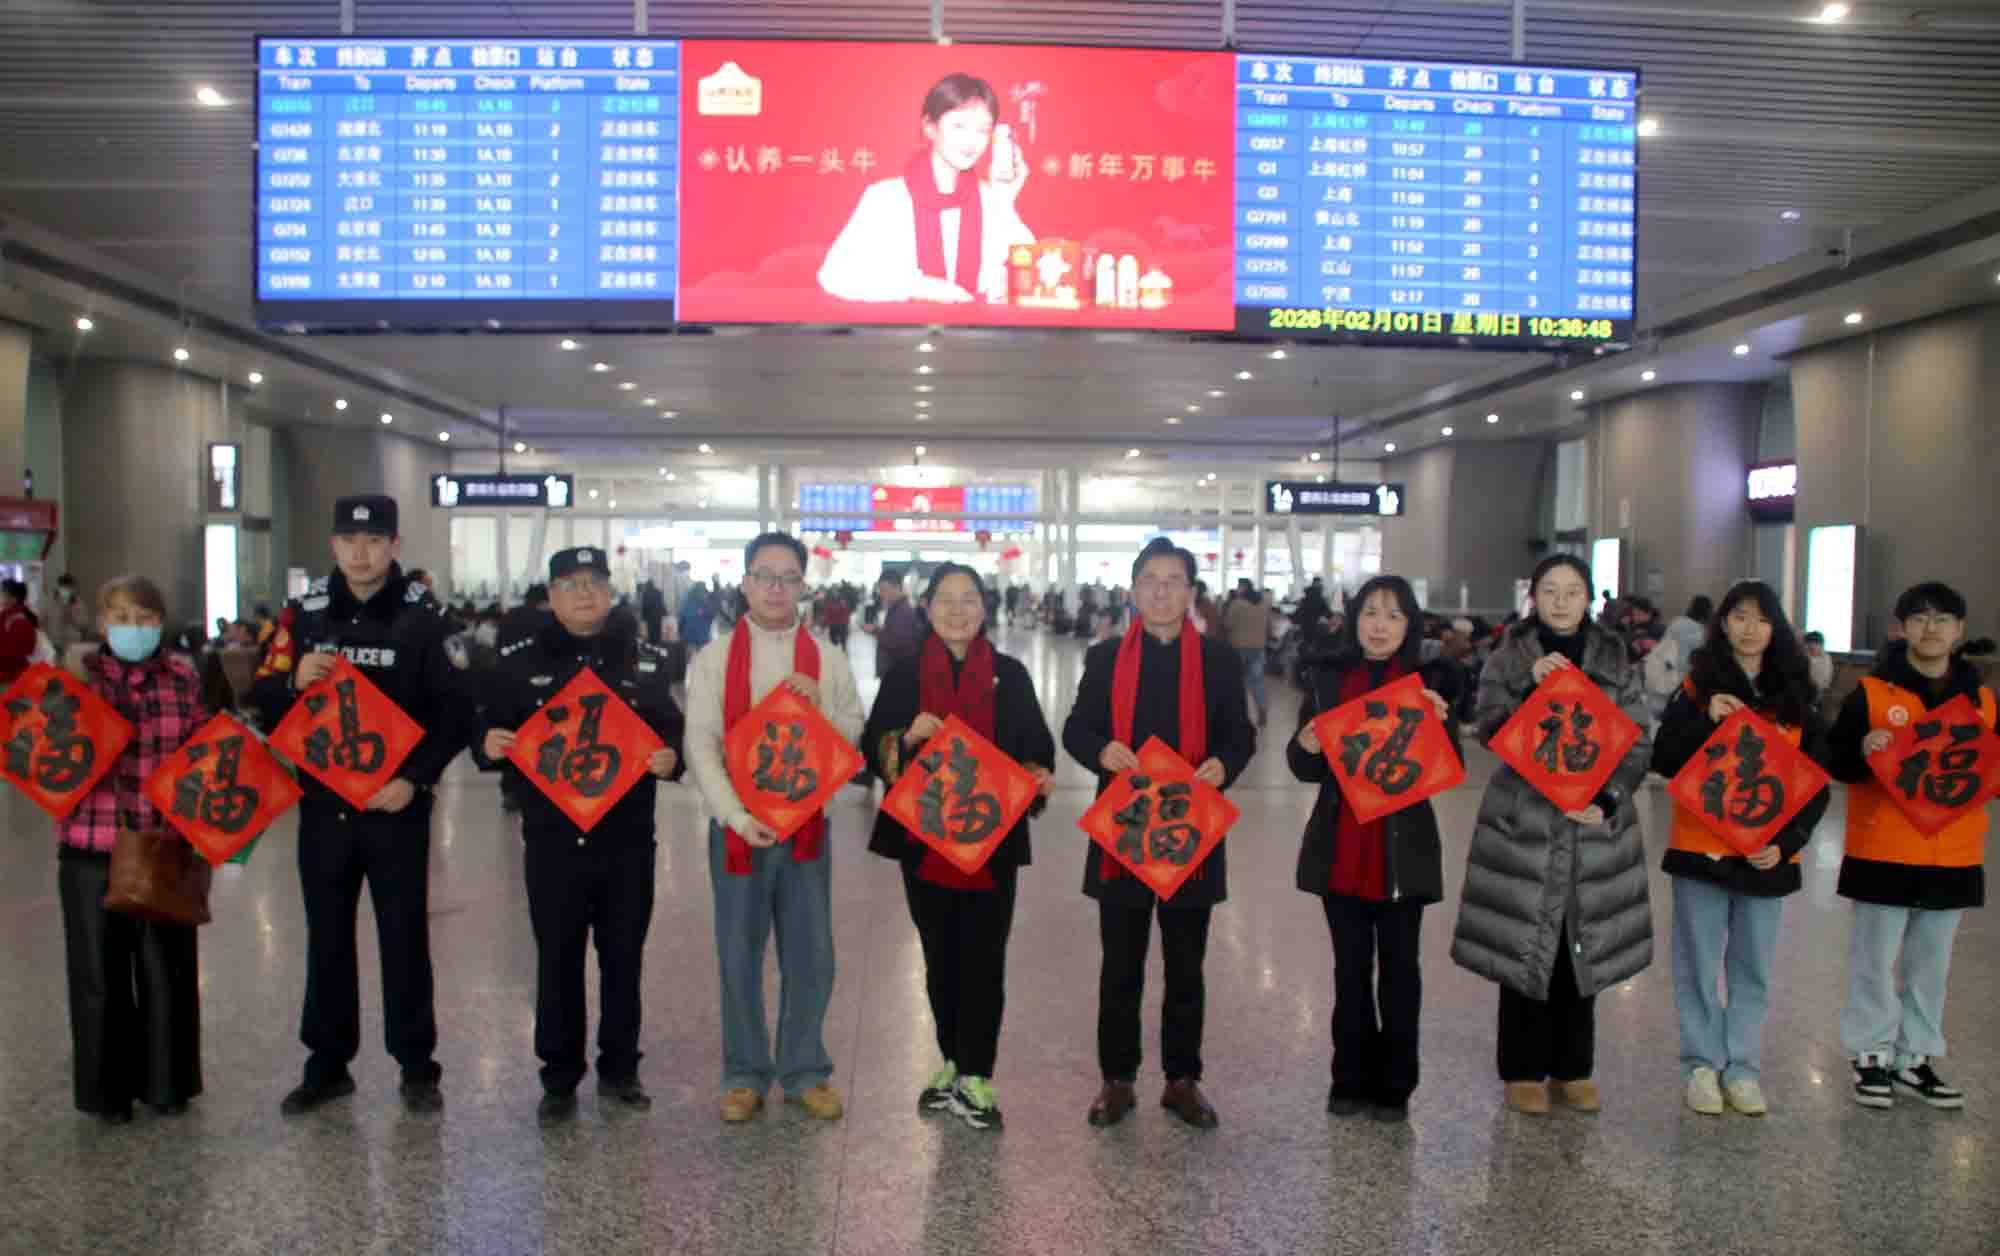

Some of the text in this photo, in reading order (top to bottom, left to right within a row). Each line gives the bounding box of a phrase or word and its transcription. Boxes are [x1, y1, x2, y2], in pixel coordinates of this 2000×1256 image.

[725, 144, 878, 176] 认养一头牛
[1068, 152, 1216, 183] 新年万事牛
[1450, 309, 1520, 337] 星期日
[2, 678, 96, 792] 福
[303, 677, 386, 774] 福
[535, 692, 622, 798] 福
[1339, 700, 1425, 795] 福
[1533, 700, 1601, 774] 福
[1895, 720, 1984, 809] 福
[172, 736, 259, 833] 福
[918, 736, 1005, 844] 福
[1114, 774, 1203, 867] 福
[1701, 723, 1785, 828] 福
